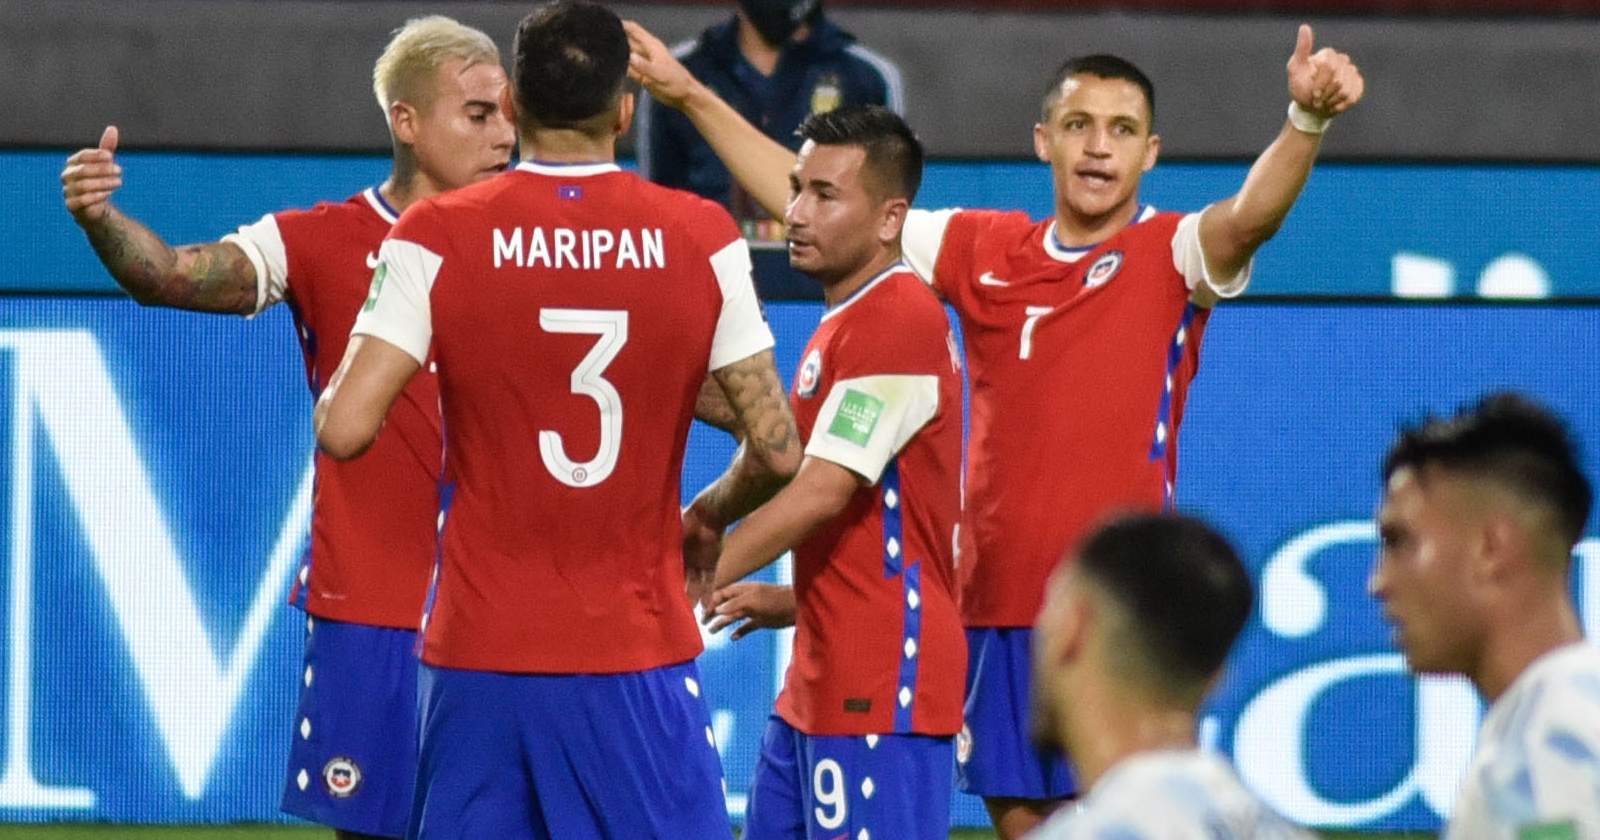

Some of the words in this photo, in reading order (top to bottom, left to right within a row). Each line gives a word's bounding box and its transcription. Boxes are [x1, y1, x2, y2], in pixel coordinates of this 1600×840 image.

[492, 226, 666, 270] MARIPAN
[1018, 305, 1055, 360] 7
[538, 307, 629, 488] 3
[813, 758, 846, 830] 9
